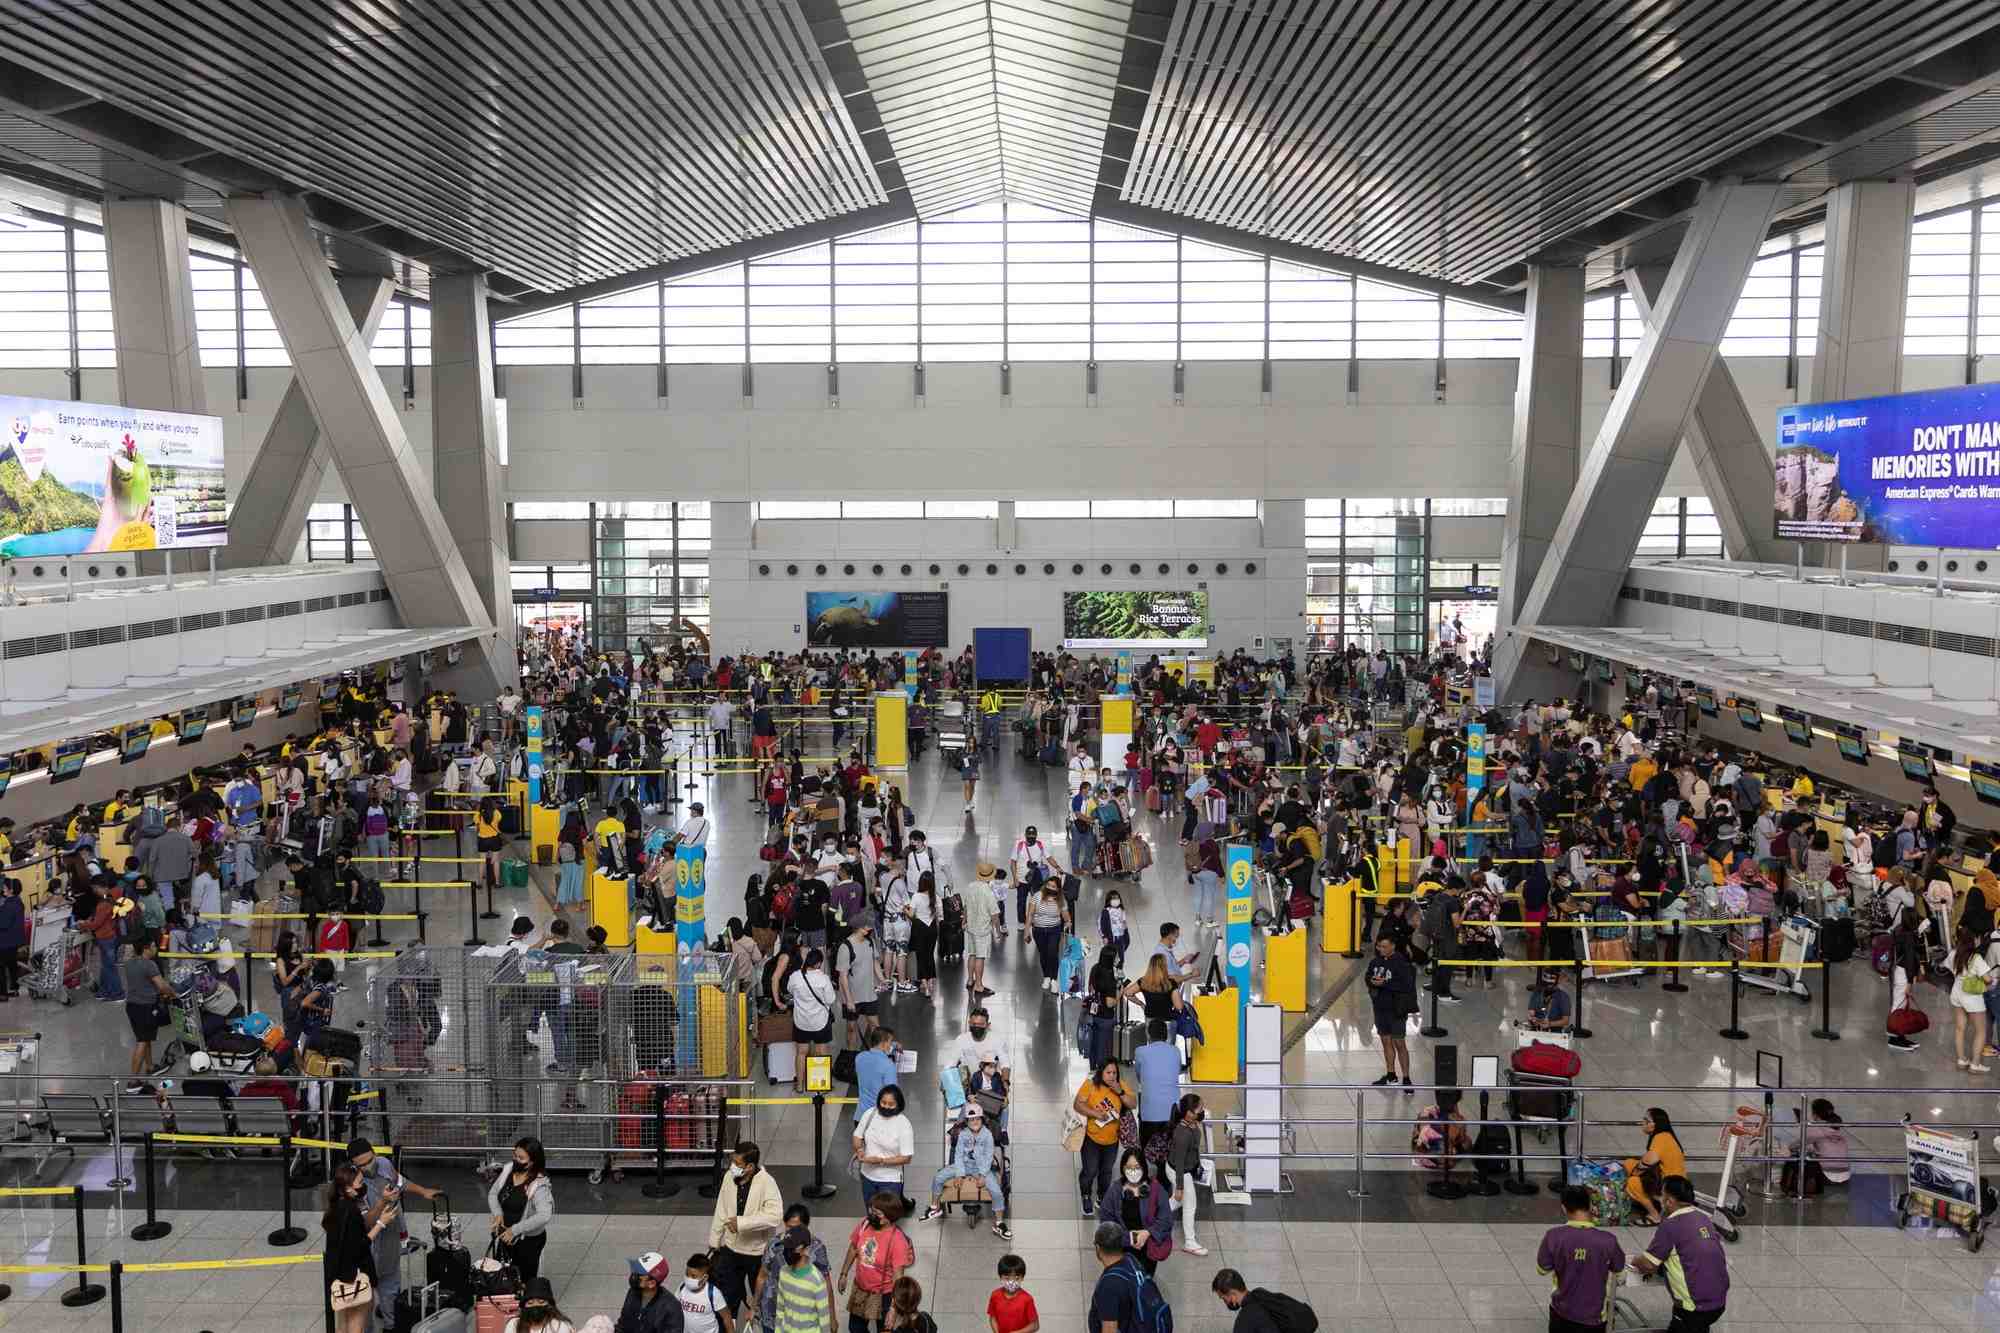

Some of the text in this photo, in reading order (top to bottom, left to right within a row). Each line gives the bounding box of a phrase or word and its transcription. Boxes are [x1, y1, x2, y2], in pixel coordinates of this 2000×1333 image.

[59, 413, 76, 424] Earn
[77, 416, 99, 426] points
[100, 418, 119, 428] when
[120, 421, 132, 431] you
[142, 421, 154, 431] and
[155, 422, 172, 432] when
[172, 424, 184, 434] you
[185, 424, 199, 435] shop
[1913, 424, 1963, 451] DON'T
[1871, 450, 2000, 479] MEMORIES WITH
[1885, 486, 1919, 498] American
[1954, 485, 1978, 498] Cards
[1152, 605, 1188, 613] Banaue
[1139, 614, 1202, 623] Rice Terraces
[1236, 871, 1245, 885] 3
[1232, 903, 1248, 912] BAG
